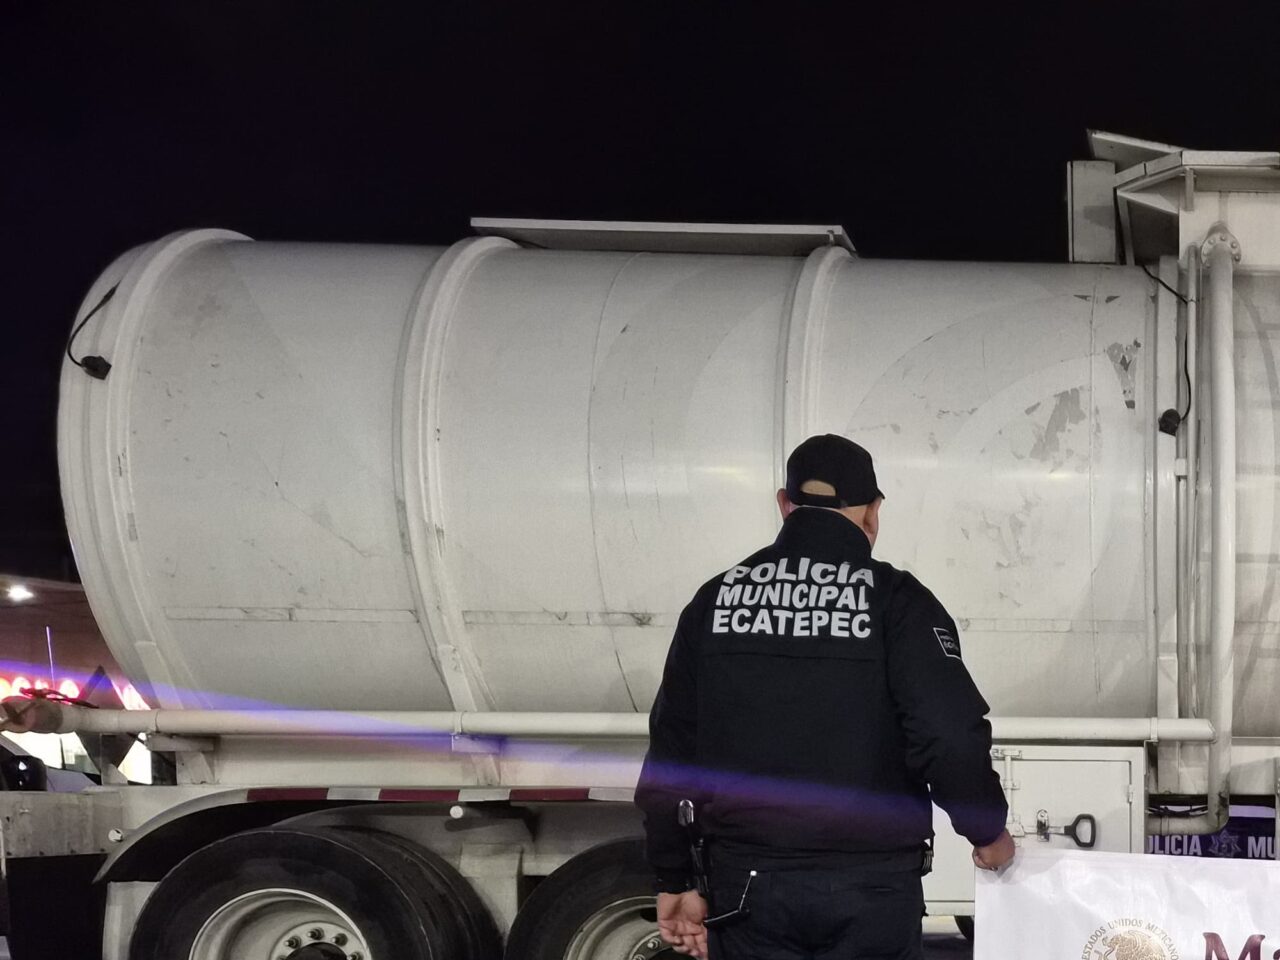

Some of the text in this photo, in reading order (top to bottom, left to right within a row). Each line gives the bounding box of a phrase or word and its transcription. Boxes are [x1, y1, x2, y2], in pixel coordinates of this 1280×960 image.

[715, 582, 869, 611] MUNICIPAL
[711, 608, 871, 638] ECATEPEC
[1082, 926, 1107, 960] ESTADOS
